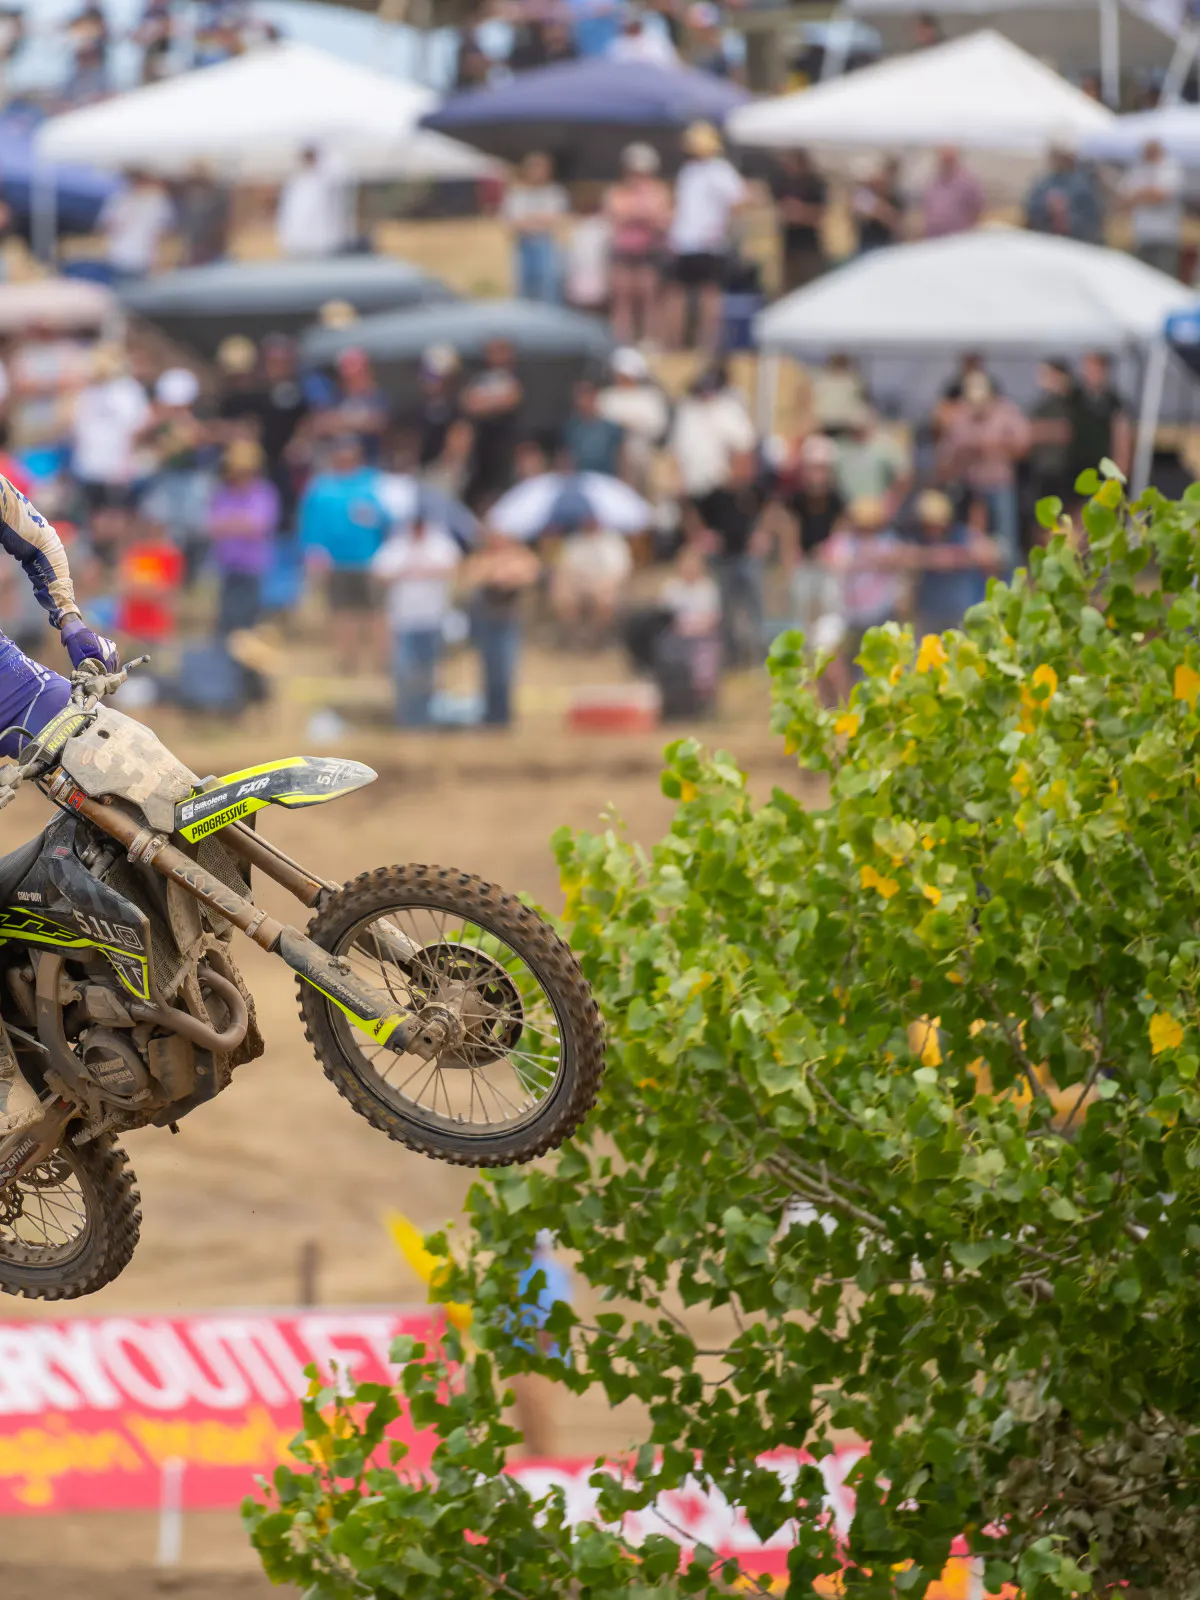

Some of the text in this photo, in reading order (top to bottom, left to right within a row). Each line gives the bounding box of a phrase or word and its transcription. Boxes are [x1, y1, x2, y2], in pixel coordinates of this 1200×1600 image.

[193, 793, 229, 812] Silkolene
[236, 777, 270, 797] FXR
[191, 801, 248, 839] PROGRESSIVE
[72, 908, 122, 944] 5.11
[319, 971, 376, 1014] PERFORMANCE
